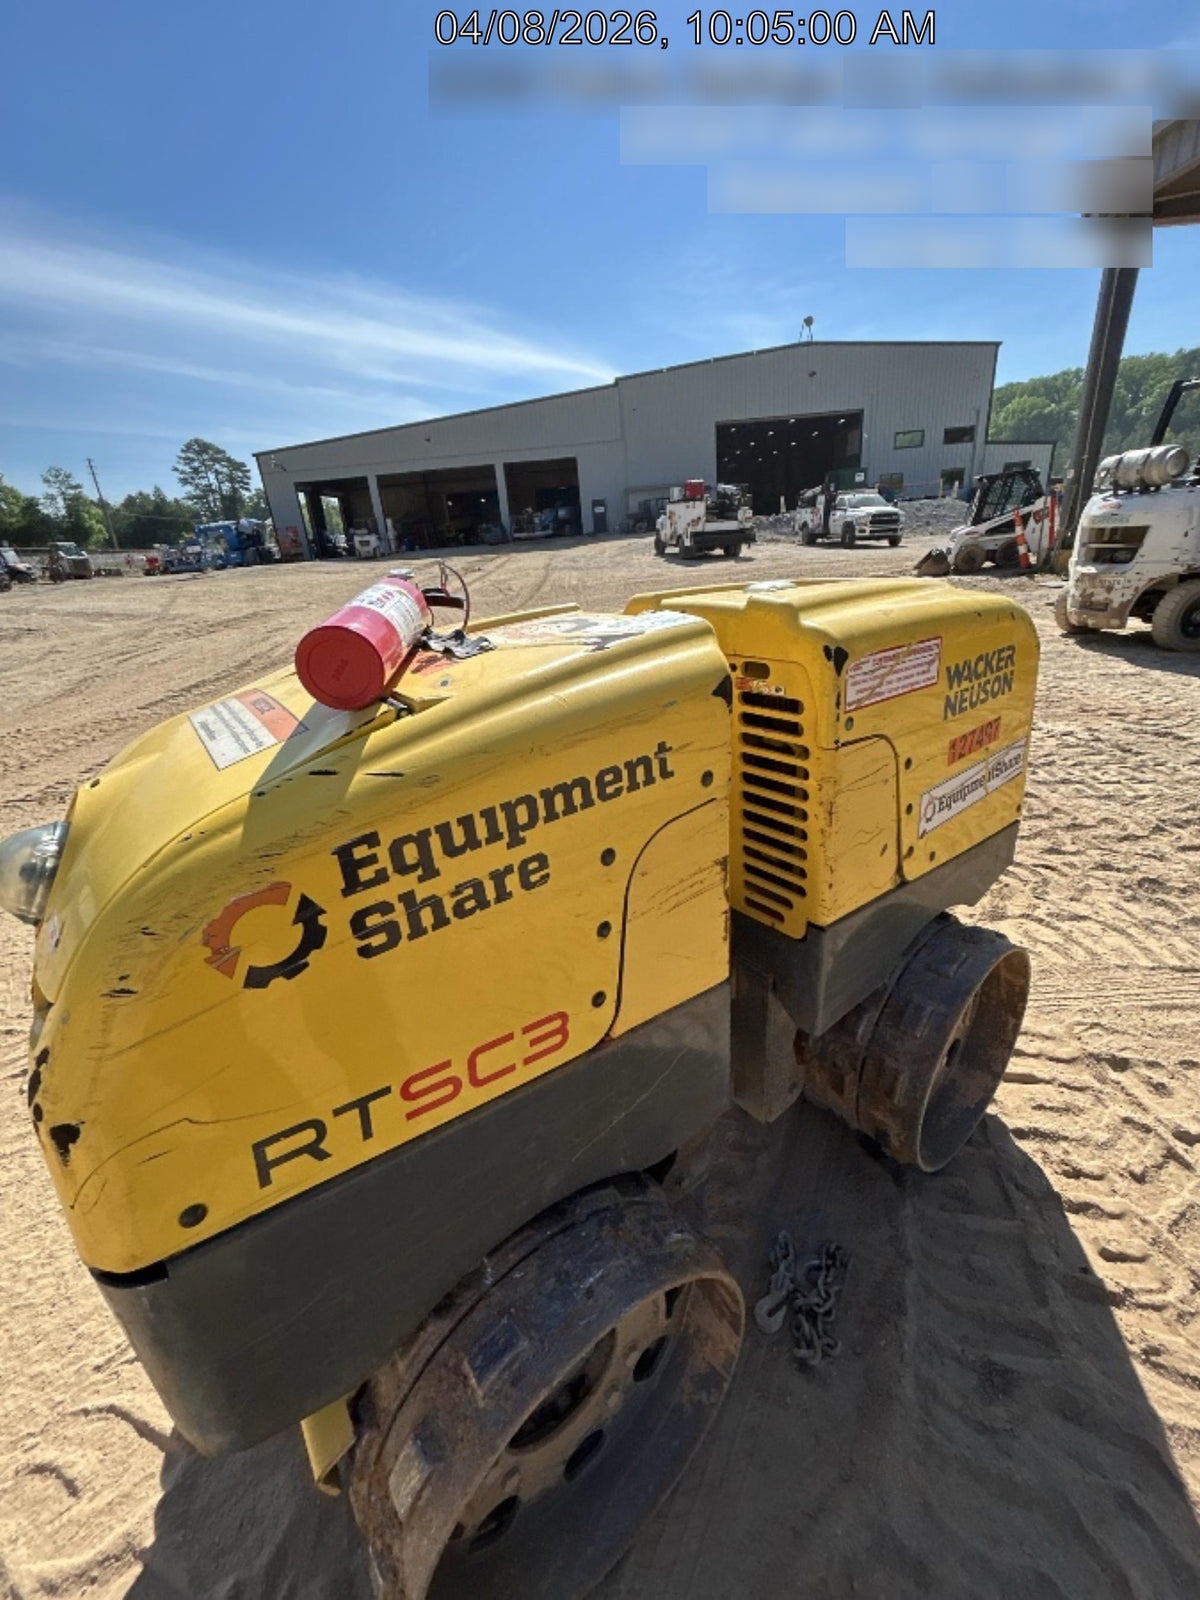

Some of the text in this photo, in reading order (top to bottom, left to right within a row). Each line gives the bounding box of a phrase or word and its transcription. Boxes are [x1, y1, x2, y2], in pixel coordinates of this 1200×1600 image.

[943, 670, 1015, 720] NEUSON
[945, 644, 1016, 691] WACKER
[332, 741, 675, 898] Equipment
[349, 852, 551, 959] Share
[252, 1011, 570, 1190] RTSC3
